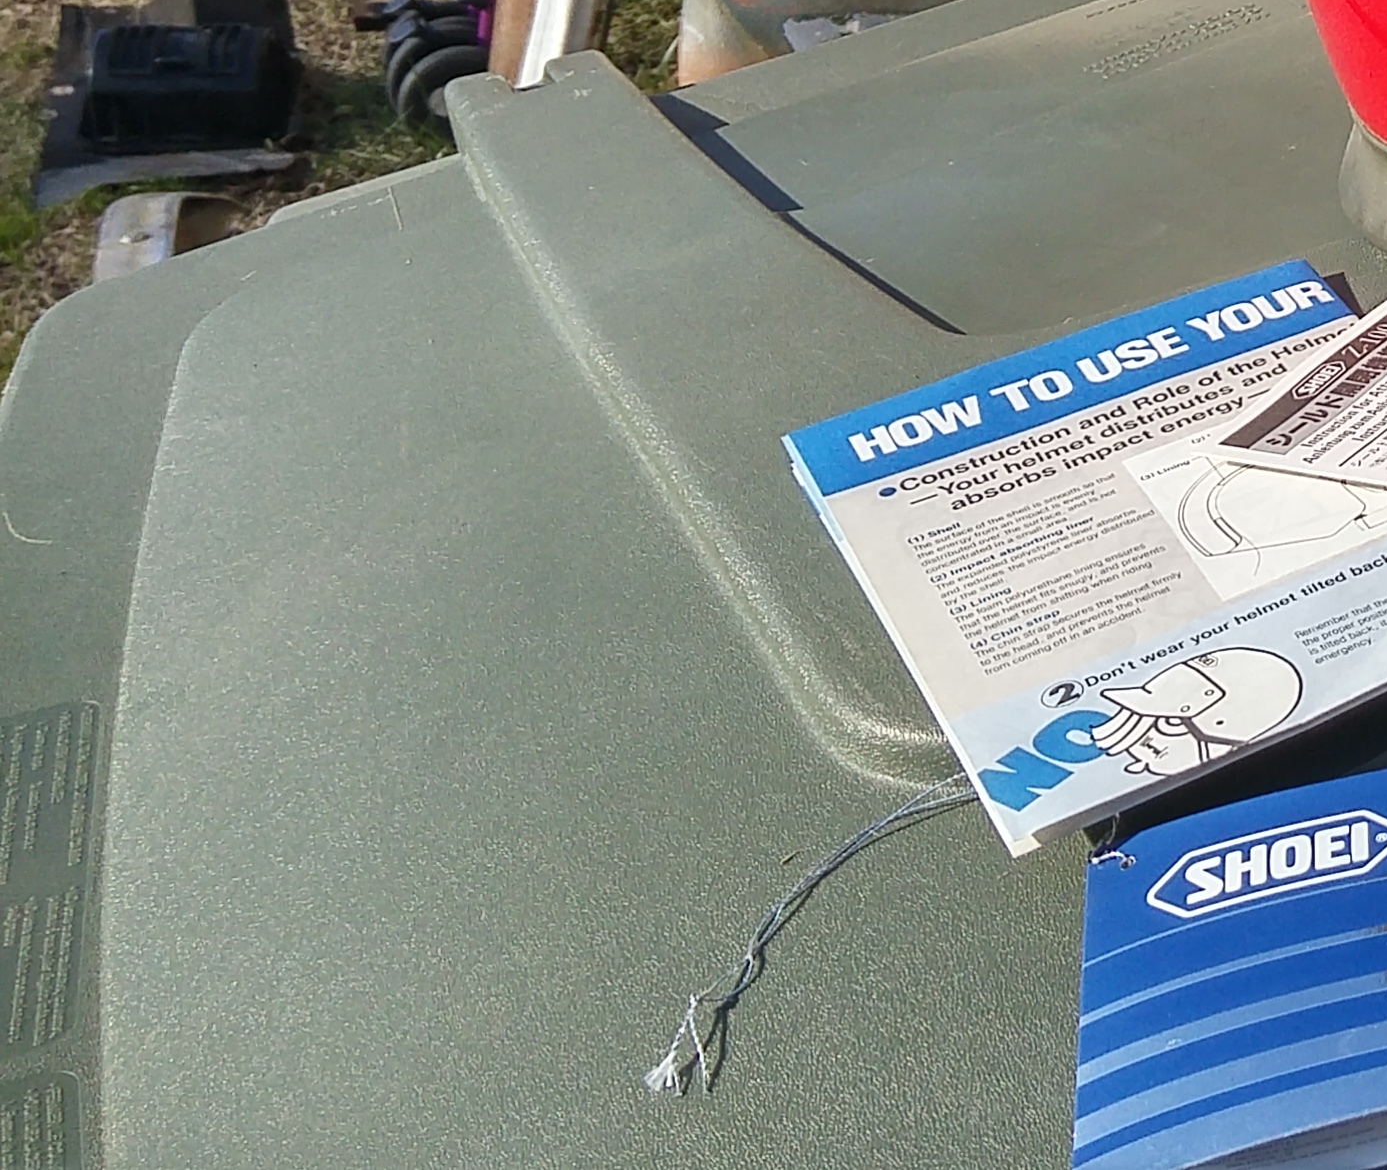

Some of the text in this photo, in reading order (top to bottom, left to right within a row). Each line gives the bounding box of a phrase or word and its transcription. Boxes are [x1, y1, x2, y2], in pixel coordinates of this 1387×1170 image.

[848, 280, 1334, 462] HOW TO USE YOUR
[1297, 363, 1347, 396] SHOEI
[899, 322, 1355, 491] Construction and Role of the Helm
[1002, 434, 1096, 474] helmet
[1099, 385, 1234, 438] distributes
[1241, 362, 1288, 388] and
[1300, 410, 1360, 448] Instruction
[1351, 397, 1374, 410] for
[950, 396, 1244, 511] absorbs impact energy
[907, 521, 961, 545] (1) Shell
[929, 516, 1094, 584] (2) Impact absorbing liner
[949, 587, 1012, 616] (3) Lining
[969, 610, 1061, 651] (4) Chin strap
[1084, 660, 1137, 688] Don't
[1139, 640, 1185, 665] wear
[1189, 621, 1229, 647] your
[1233, 593, 1298, 626] helmet
[1300, 571, 1348, 597] tilted
[1294, 612, 1350, 640] Remember
[1350, 603, 1373, 617] that
[1314, 637, 1372, 665] emergency.
[1046, 681, 1083, 708] 2
[977, 710, 1112, 812] NO
[1185, 822, 1369, 905] SHOEI
